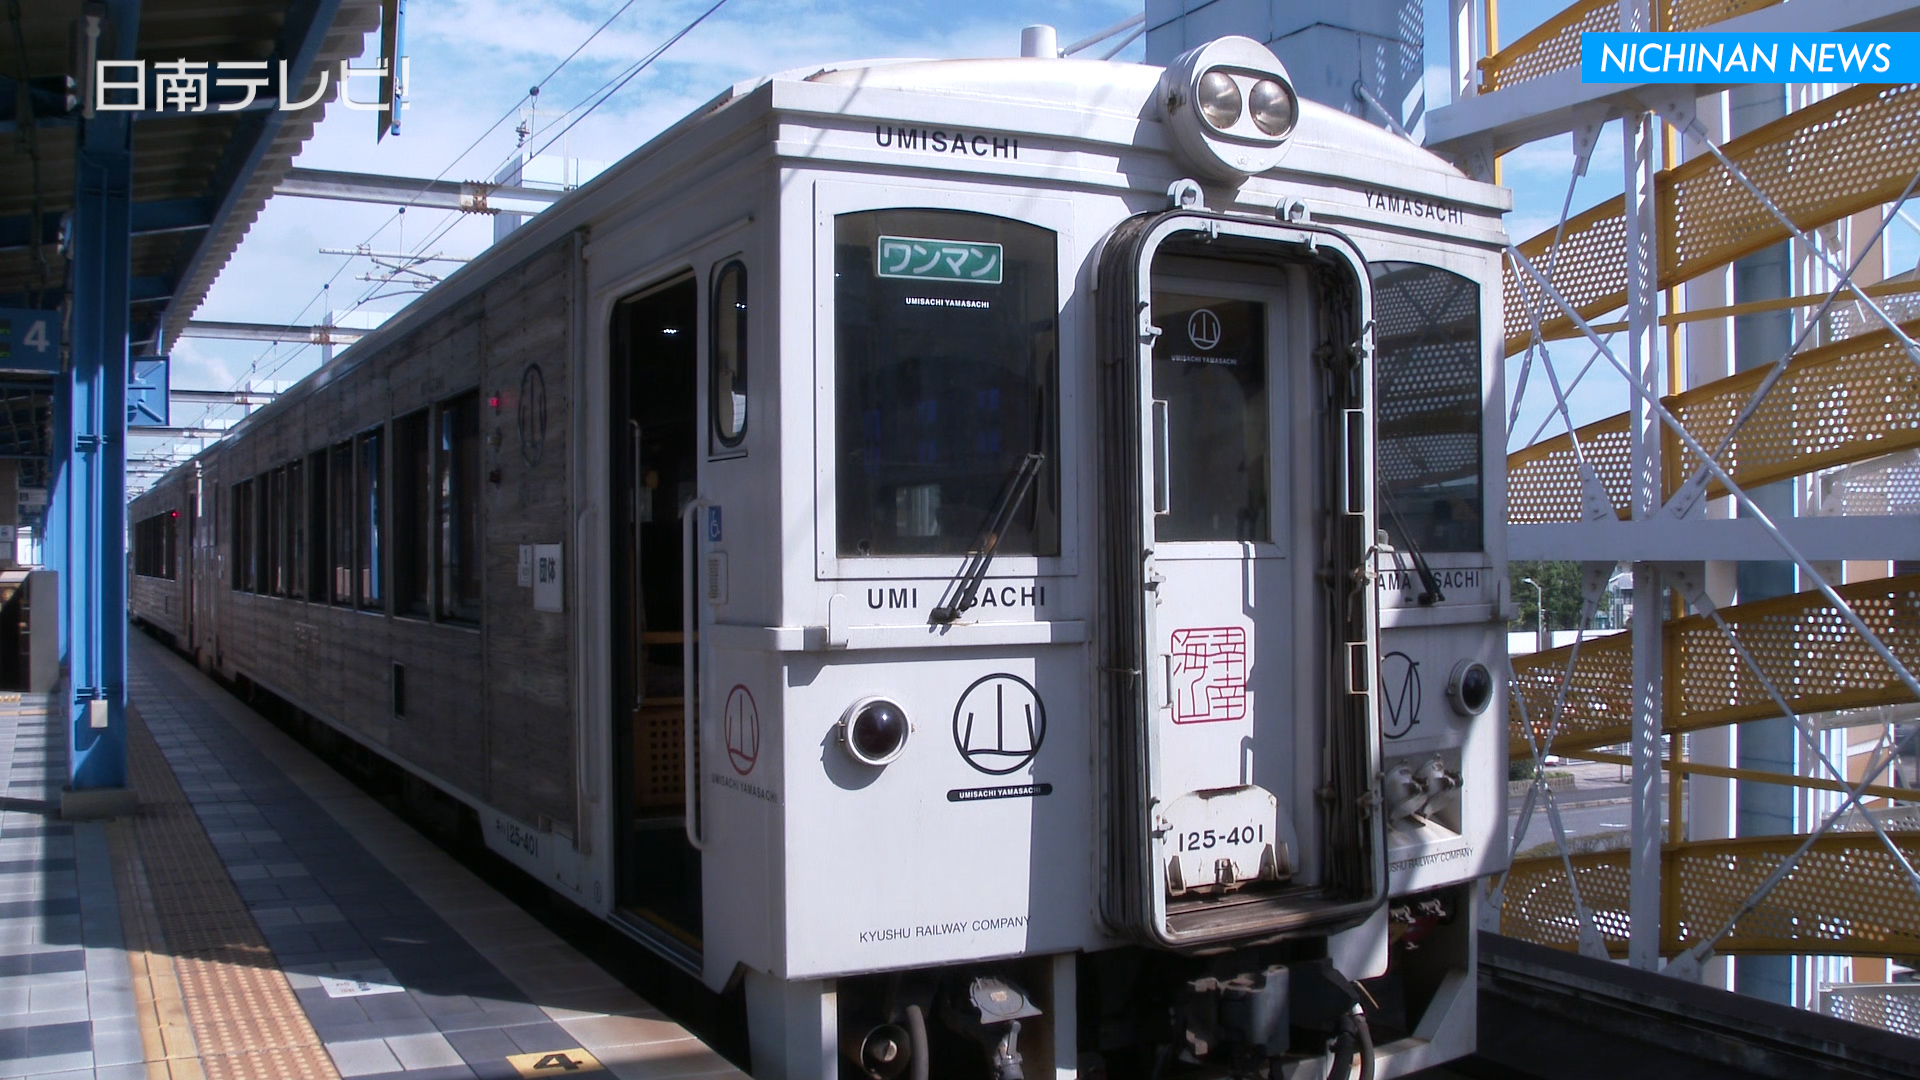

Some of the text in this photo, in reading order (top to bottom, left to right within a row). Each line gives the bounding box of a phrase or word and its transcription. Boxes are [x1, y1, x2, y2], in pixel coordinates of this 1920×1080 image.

[876, 126, 1019, 159] UMISACHI
[1365, 189, 1463, 225] YAMASACHI
[883, 242, 996, 277] ワンマン
[905, 297, 990, 309] UMISACHI YAMASACHI
[23, 320, 51, 352] 4
[539, 557, 556, 584] 団体
[1379, 573, 1411, 590] AMA
[867, 588, 918, 609] UMI
[959, 786, 1041, 799] UMISACHI YAMASACHI
[1179, 824, 1263, 852] 125-401
[1408, 853, 1439, 869] RAILWAY
[1441, 846, 1474, 862] COMPANY
[859, 916, 1031, 943] KYUSHU RAILWAY COMPANY
[533, 1053, 583, 1070] 4
